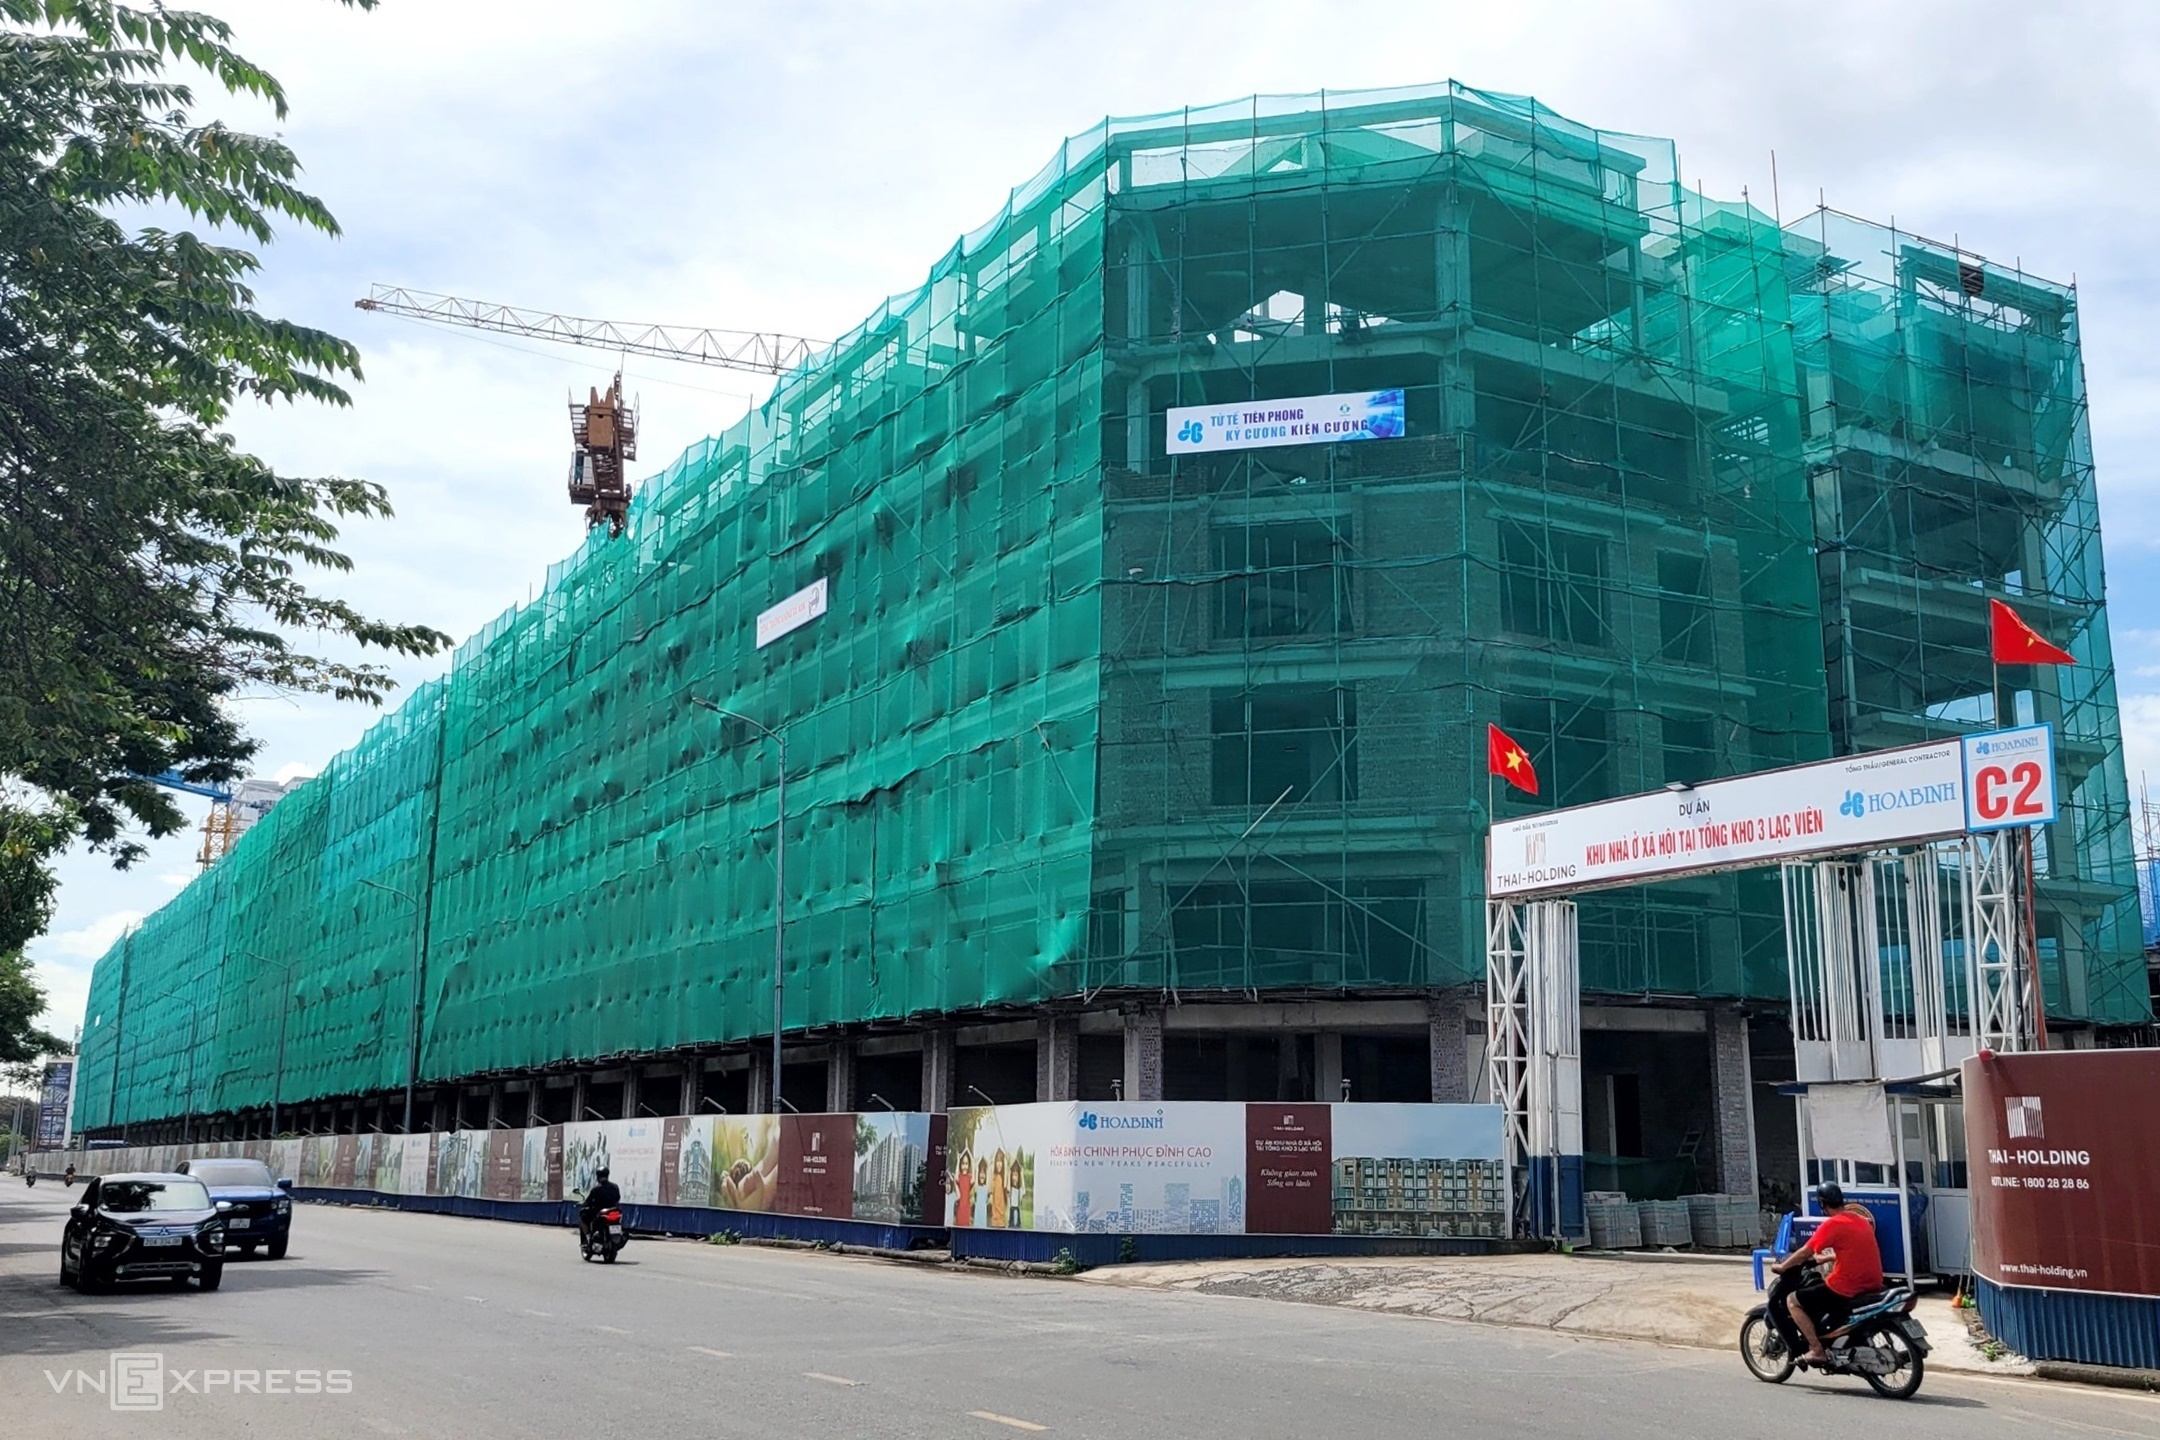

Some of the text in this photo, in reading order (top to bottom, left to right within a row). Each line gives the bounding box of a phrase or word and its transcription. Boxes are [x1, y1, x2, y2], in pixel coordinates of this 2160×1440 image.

[1243, 411, 1266, 424] TIÊN
[1267, 408, 1304, 423] PHONG
[1245, 425, 1287, 440] CƯƠNG
[1291, 422, 1319, 437] KIÊN
[1991, 736, 2039, 753] HOABINH
[1908, 749, 1951, 764] CONTRACTOR
[1869, 782, 1957, 813] HOABINH
[1975, 761, 2043, 819] C2
[1679, 799, 1711, 818] DỰ ÁN
[1586, 806, 1824, 867] KHU NHÀ Ở XÃ HỘI TẠI TỔNG KHO 3 LẠC VIÊN
[1497, 864, 1576, 888] THAI-HOLDING
[1100, 1116, 1164, 1129] HOABINH
[1084, 1146, 1119, 1158] CHINH
[1122, 1146, 1153, 1160] PHỤC
[1187, 1146, 1212, 1158] CAO
[1988, 1150, 2090, 1166] THAI-HOLDING
[1148, 1160, 1211, 1168] PEACEFULLY
[1261, 1169, 1317, 1178] Không gian xanh
[2022, 1177, 2045, 1189] 1800
[2047, 1177, 2060, 1189] 28
[2061, 1178, 2075, 1190] 28
[2076, 1178, 2090, 1190] 86
[2000, 1263, 2088, 1279] www.thai-holding.vn
